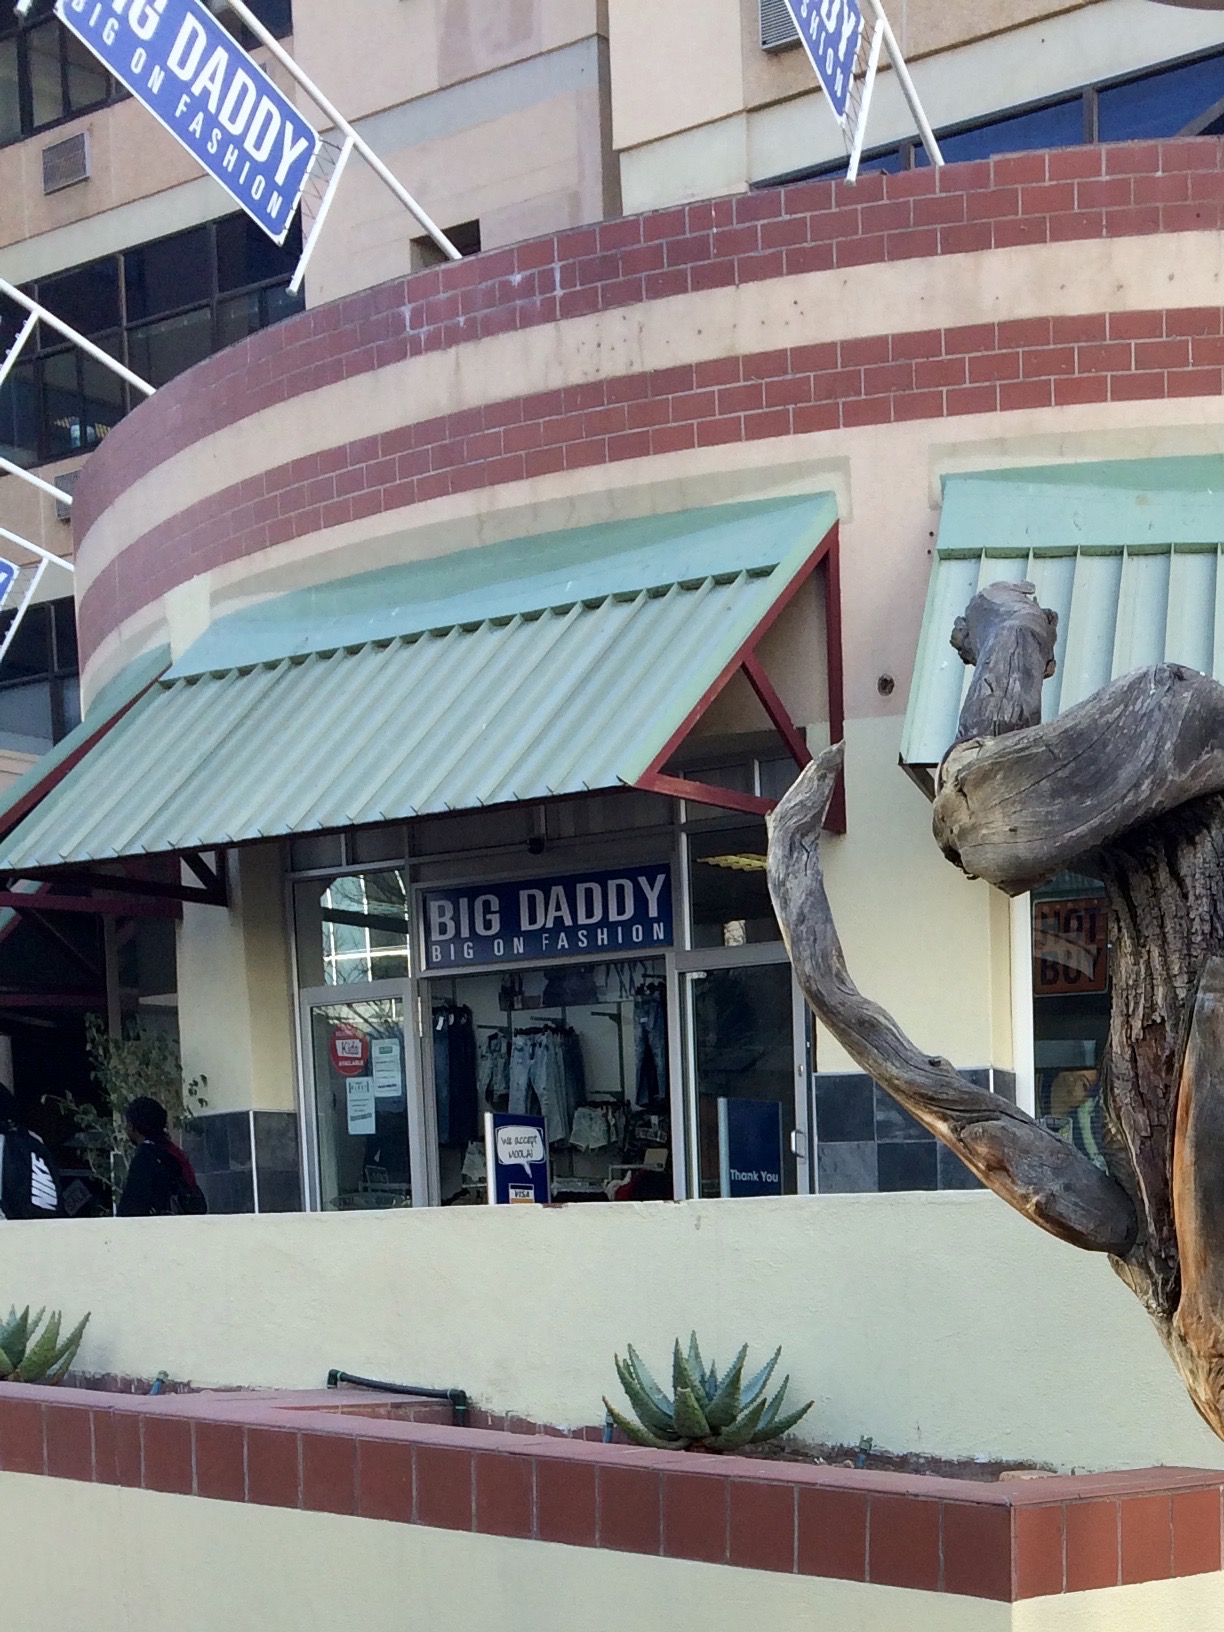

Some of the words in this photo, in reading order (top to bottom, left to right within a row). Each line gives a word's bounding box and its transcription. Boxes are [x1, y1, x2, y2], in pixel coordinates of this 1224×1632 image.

[167, 11, 308, 187] DADDY
[130, 47, 165, 95] ON
[175, 93, 283, 219] FASHION
[430, 894, 501, 941] BIG
[519, 874, 667, 931] DADDY
[432, 942, 474, 962] BIG
[494, 937, 524, 956] ON
[542, 922, 664, 951] FASHION
[31, 1152, 57, 1211] NIKE
[730, 1169, 760, 1181] Thank
[760, 1171, 779, 1183] You
